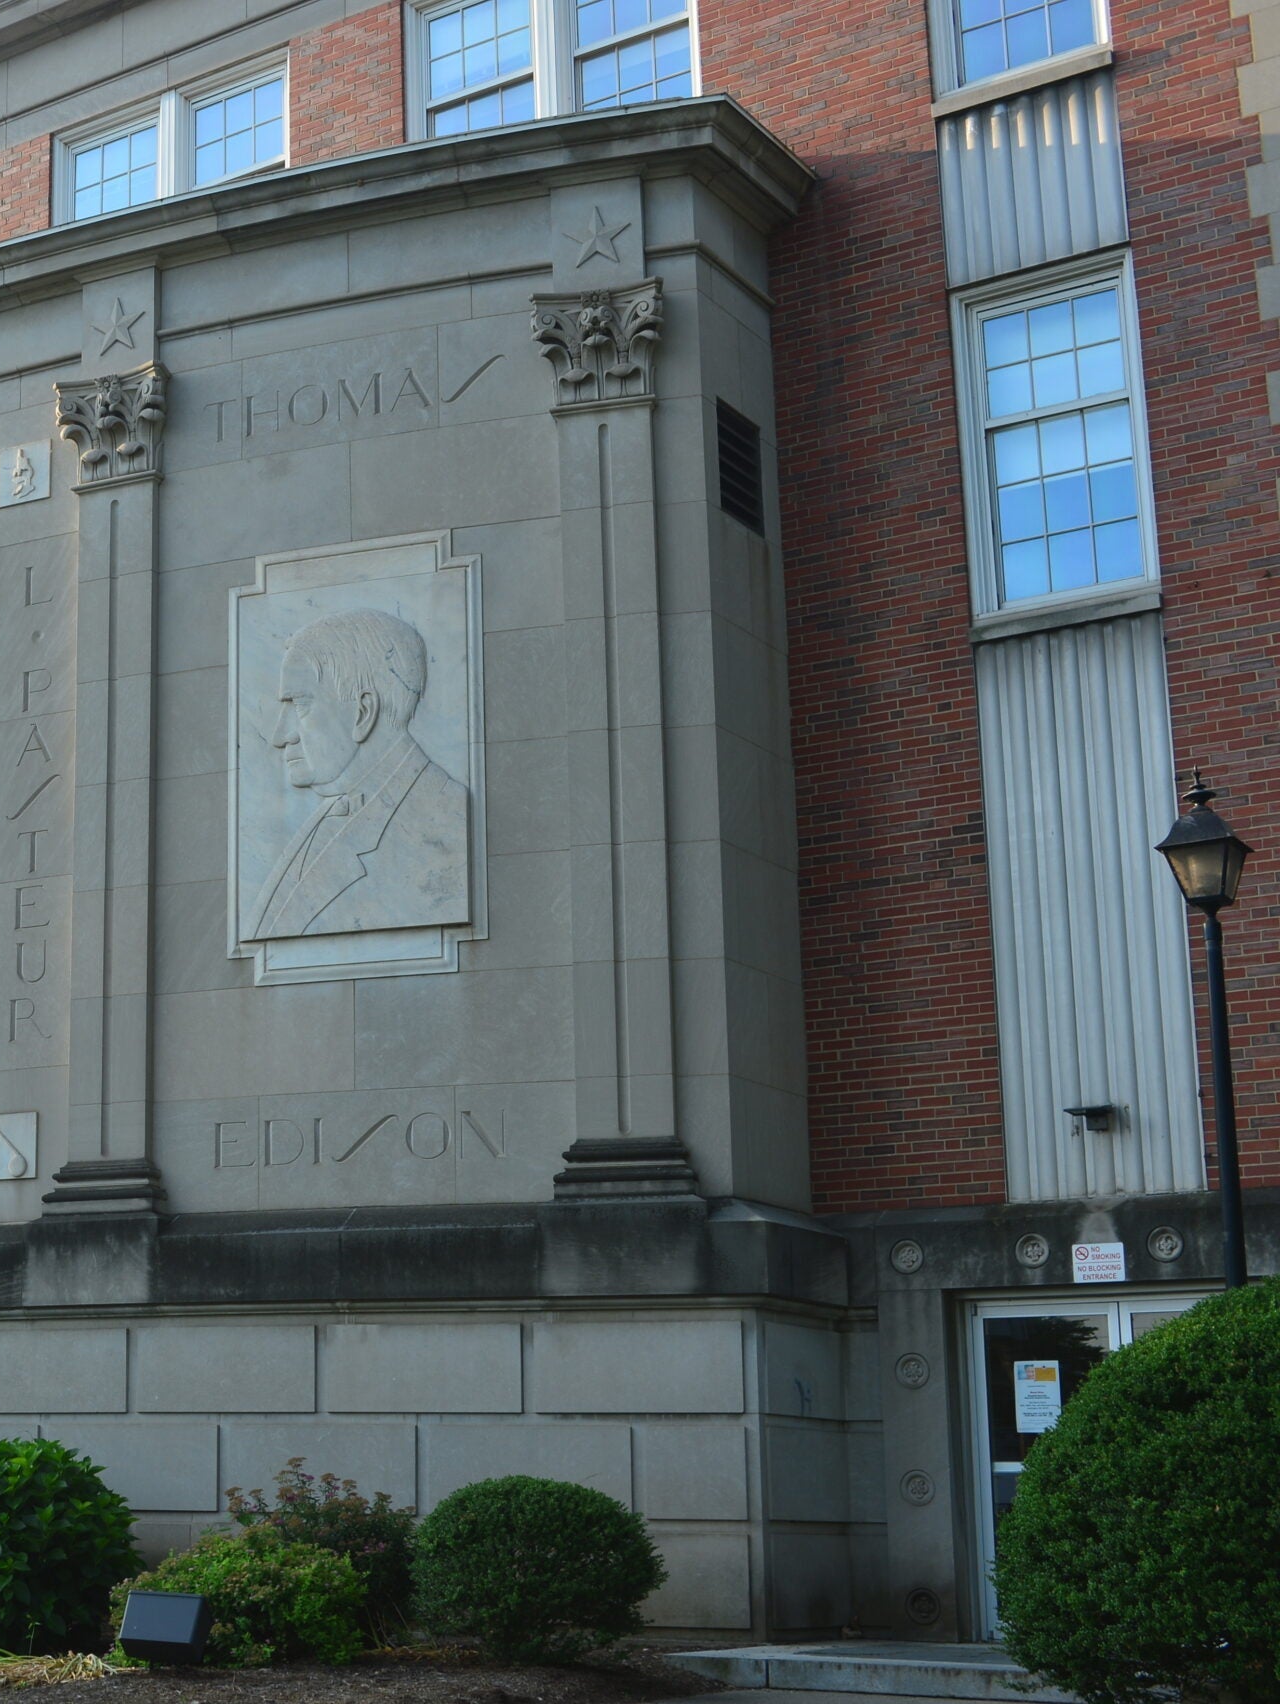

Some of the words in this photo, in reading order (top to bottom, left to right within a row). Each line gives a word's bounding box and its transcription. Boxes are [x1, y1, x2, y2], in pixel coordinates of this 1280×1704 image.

[203, 354, 508, 443] THOMAS
[5, 667, 63, 1044] PASTEUR
[214, 1108, 506, 1169] EDISON
[1089, 1264, 1121, 1272] BLOCKING
